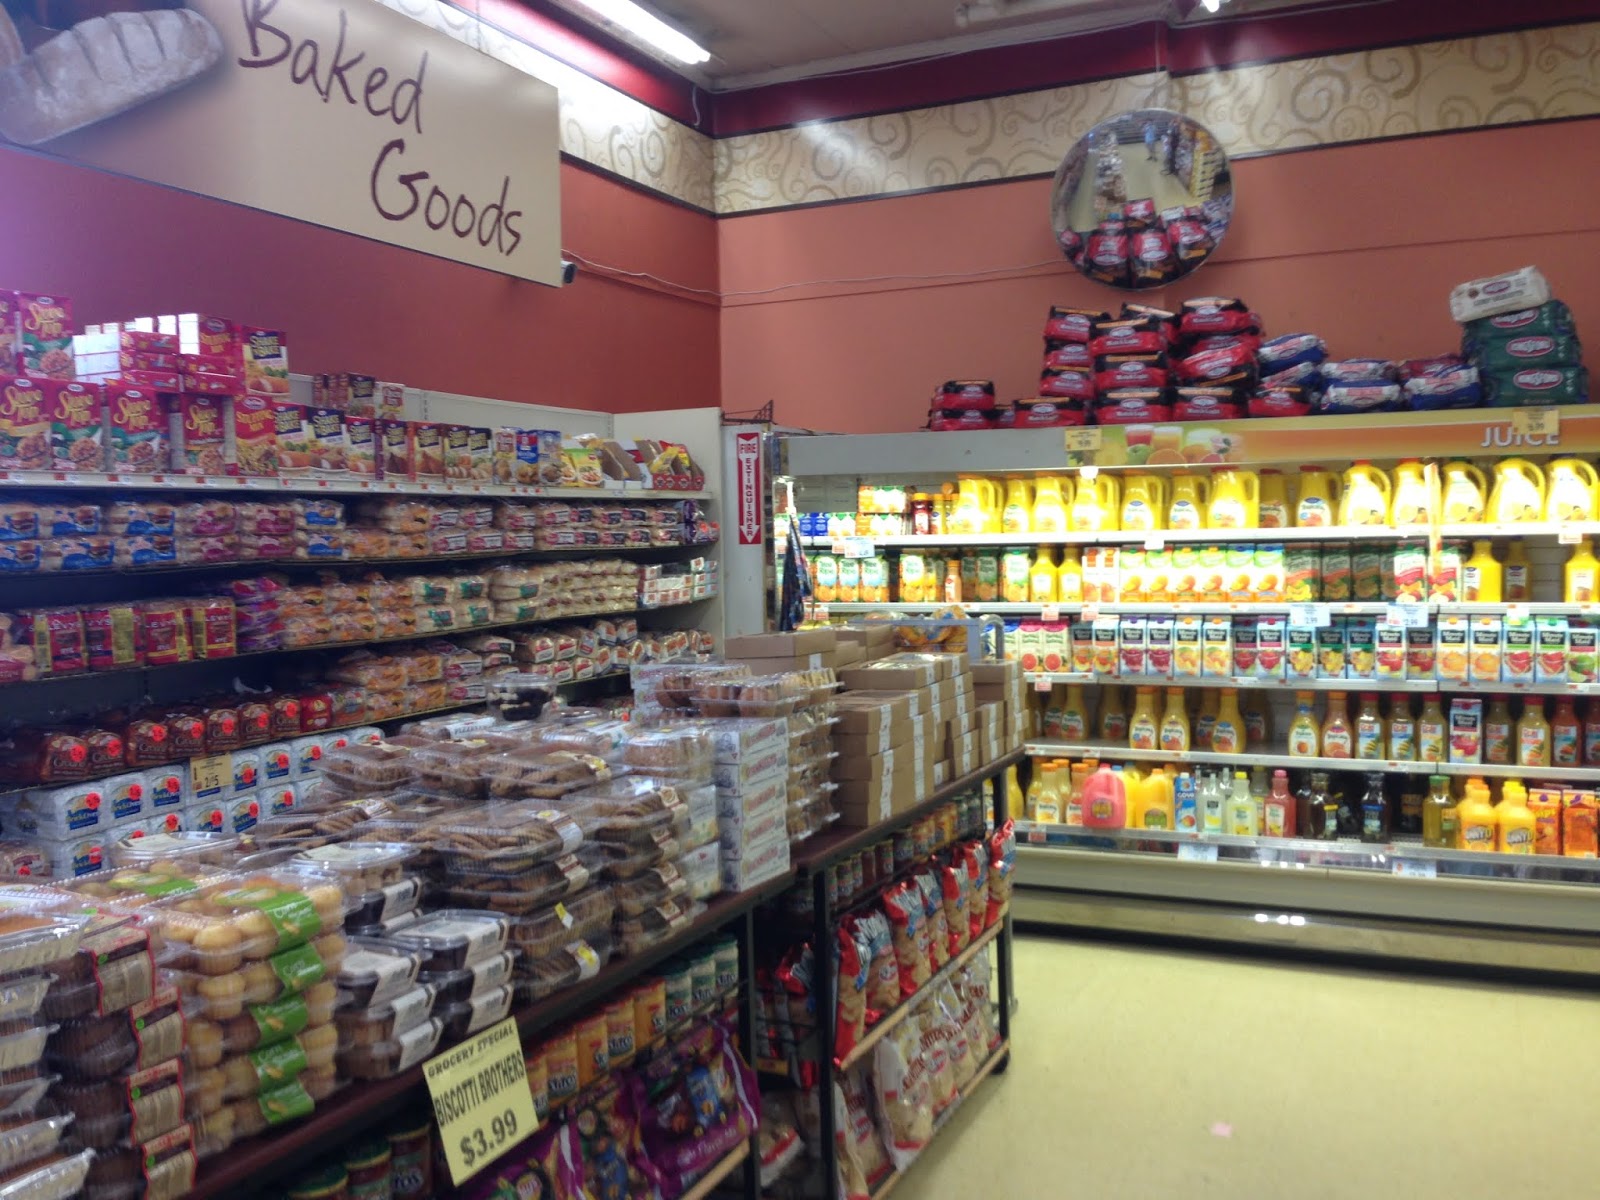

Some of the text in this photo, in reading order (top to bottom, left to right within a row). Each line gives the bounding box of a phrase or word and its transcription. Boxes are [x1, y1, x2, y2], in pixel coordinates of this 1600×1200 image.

[238, 0, 429, 135] Baked
[370, 138, 523, 256] Goods
[740, 443, 756, 454] FIRE
[1480, 426, 1559, 447] JUICE
[745, 457, 753, 536] EXTINGUISHER
[428, 1024, 514, 1077] GROCERY SPECIAL
[434, 1051, 525, 1128] BISCOTTI BROTHERS
[460, 1109, 517, 1167] $3.99
